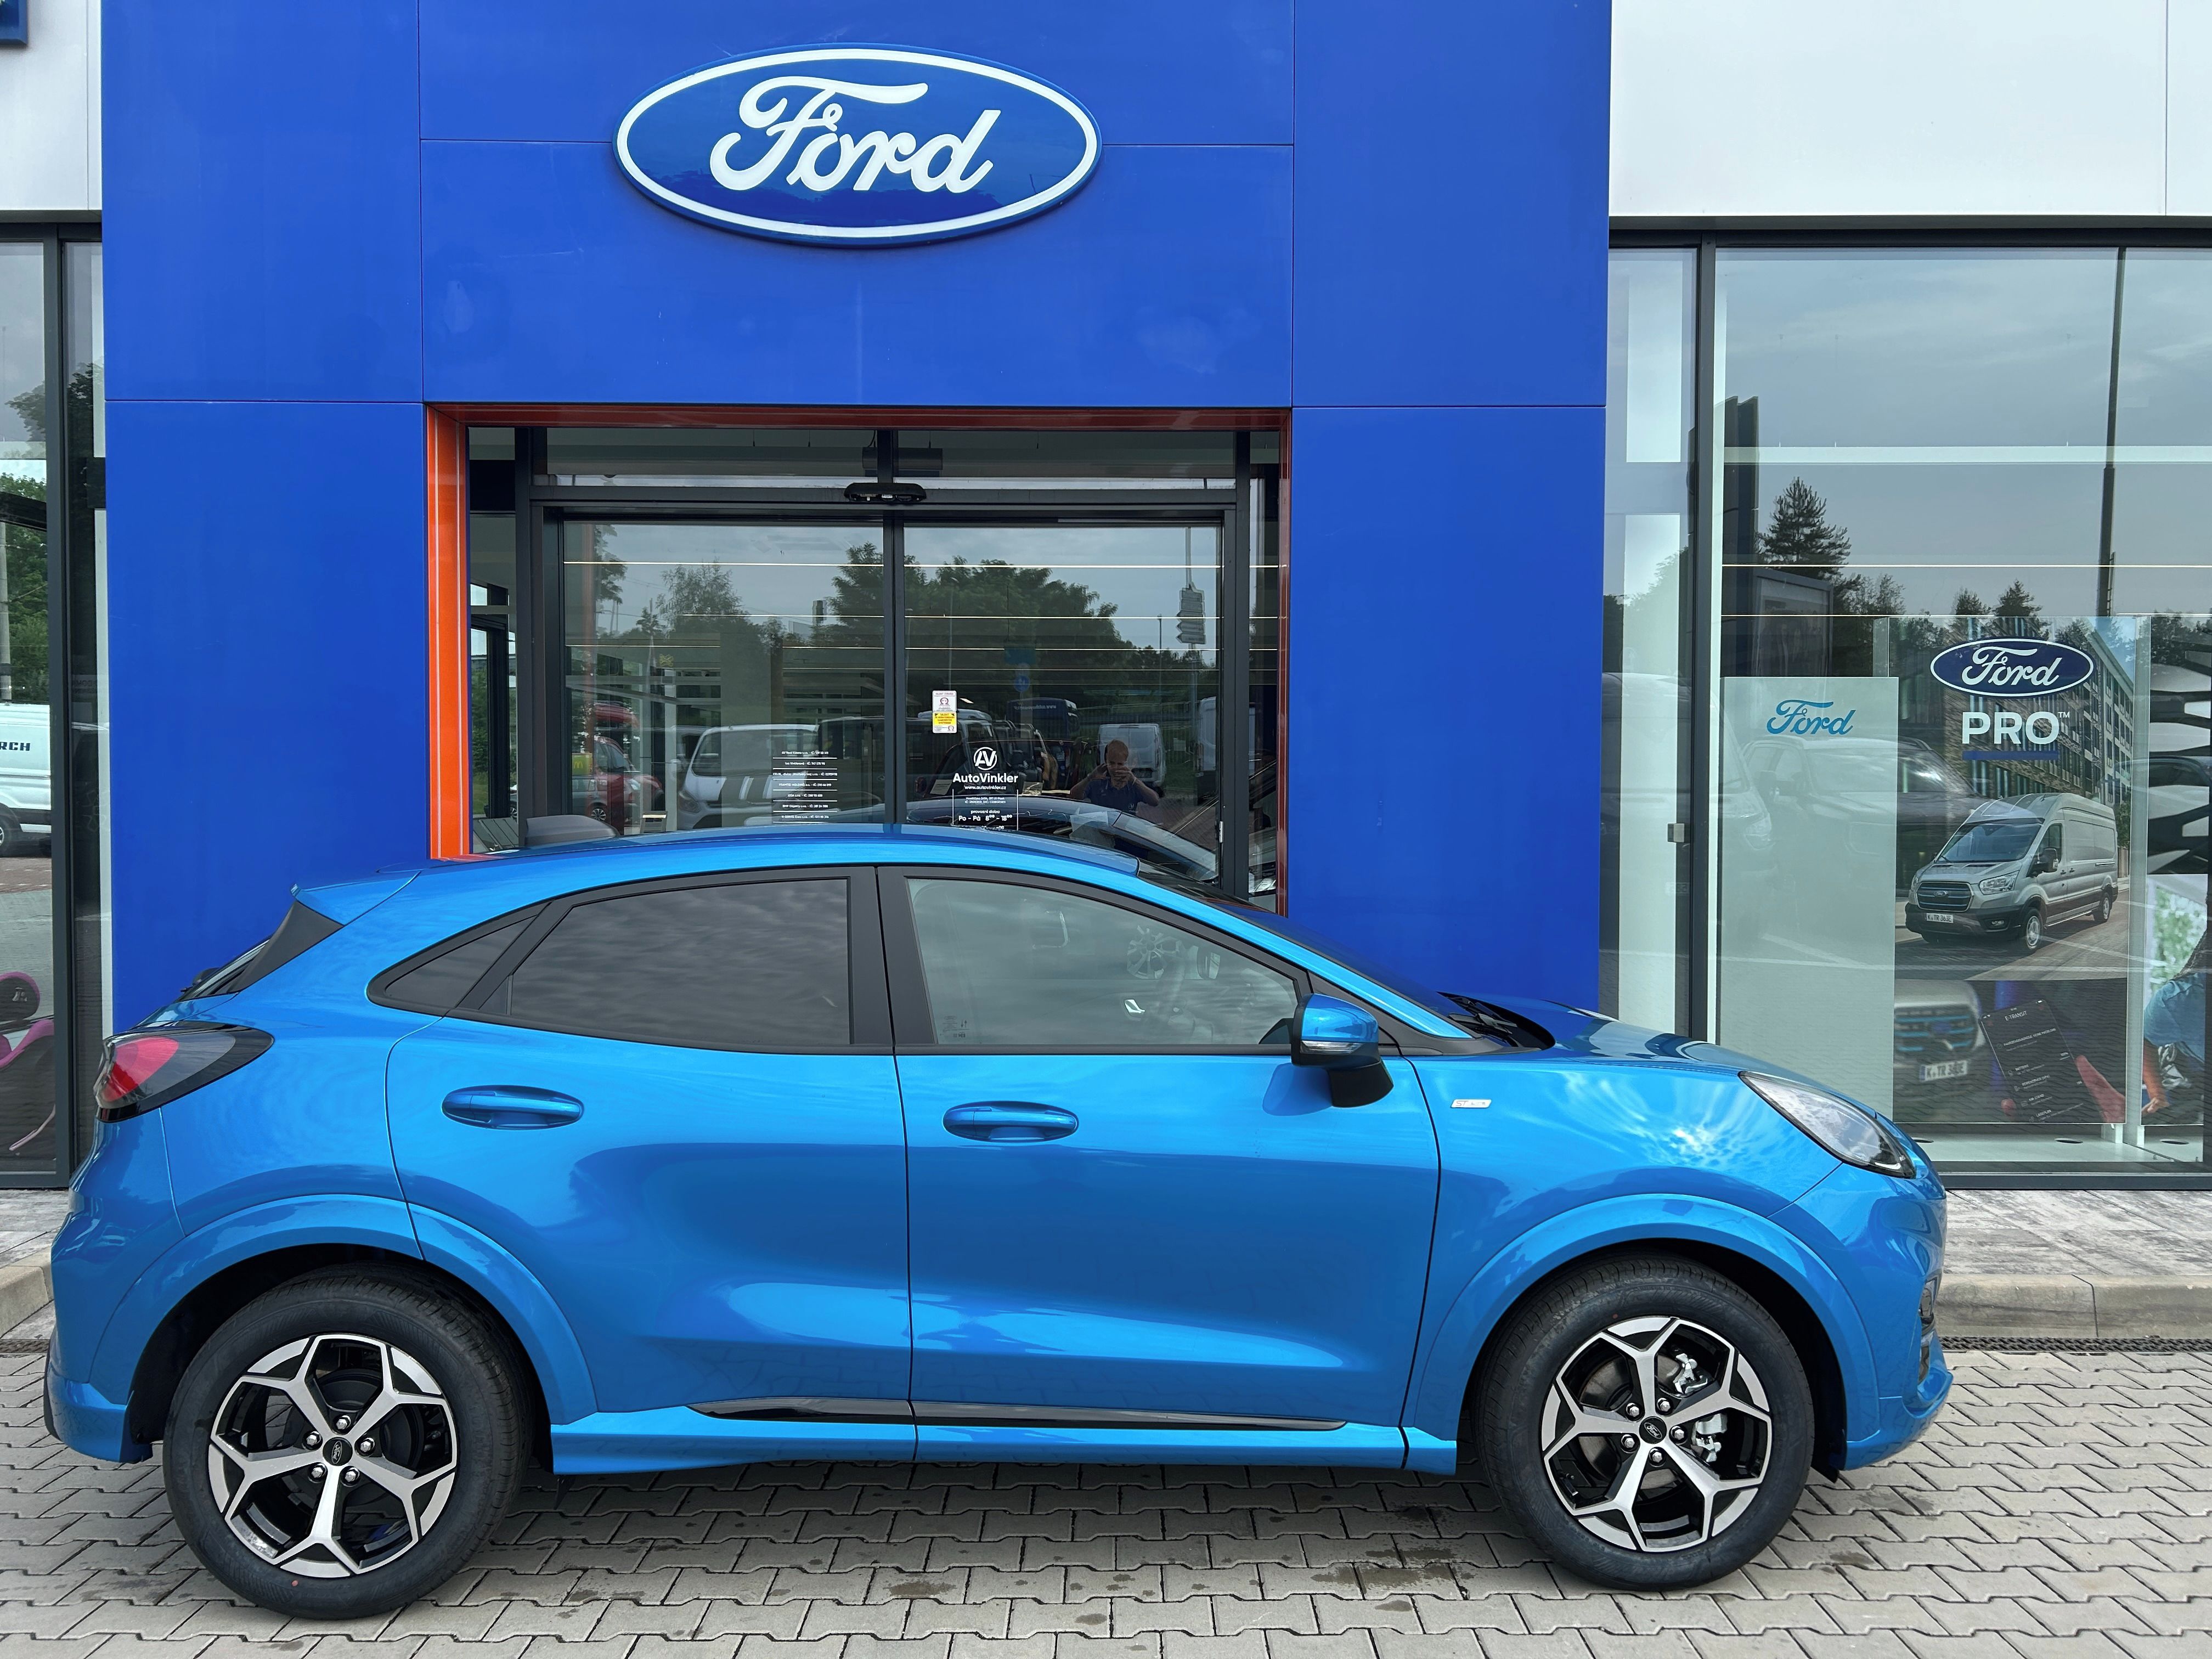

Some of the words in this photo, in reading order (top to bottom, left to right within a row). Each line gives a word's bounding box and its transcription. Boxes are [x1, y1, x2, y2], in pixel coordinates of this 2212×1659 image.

[710, 75, 1001, 194] Ford
[1961, 646, 2063, 686] Ford
[1767, 699, 1856, 735] Ford
[1962, 712, 2059, 745] PRO
[952, 772, 1018, 783] AutoVinkler
[2005, 1011, 2028, 1021] E-TRANSIT
